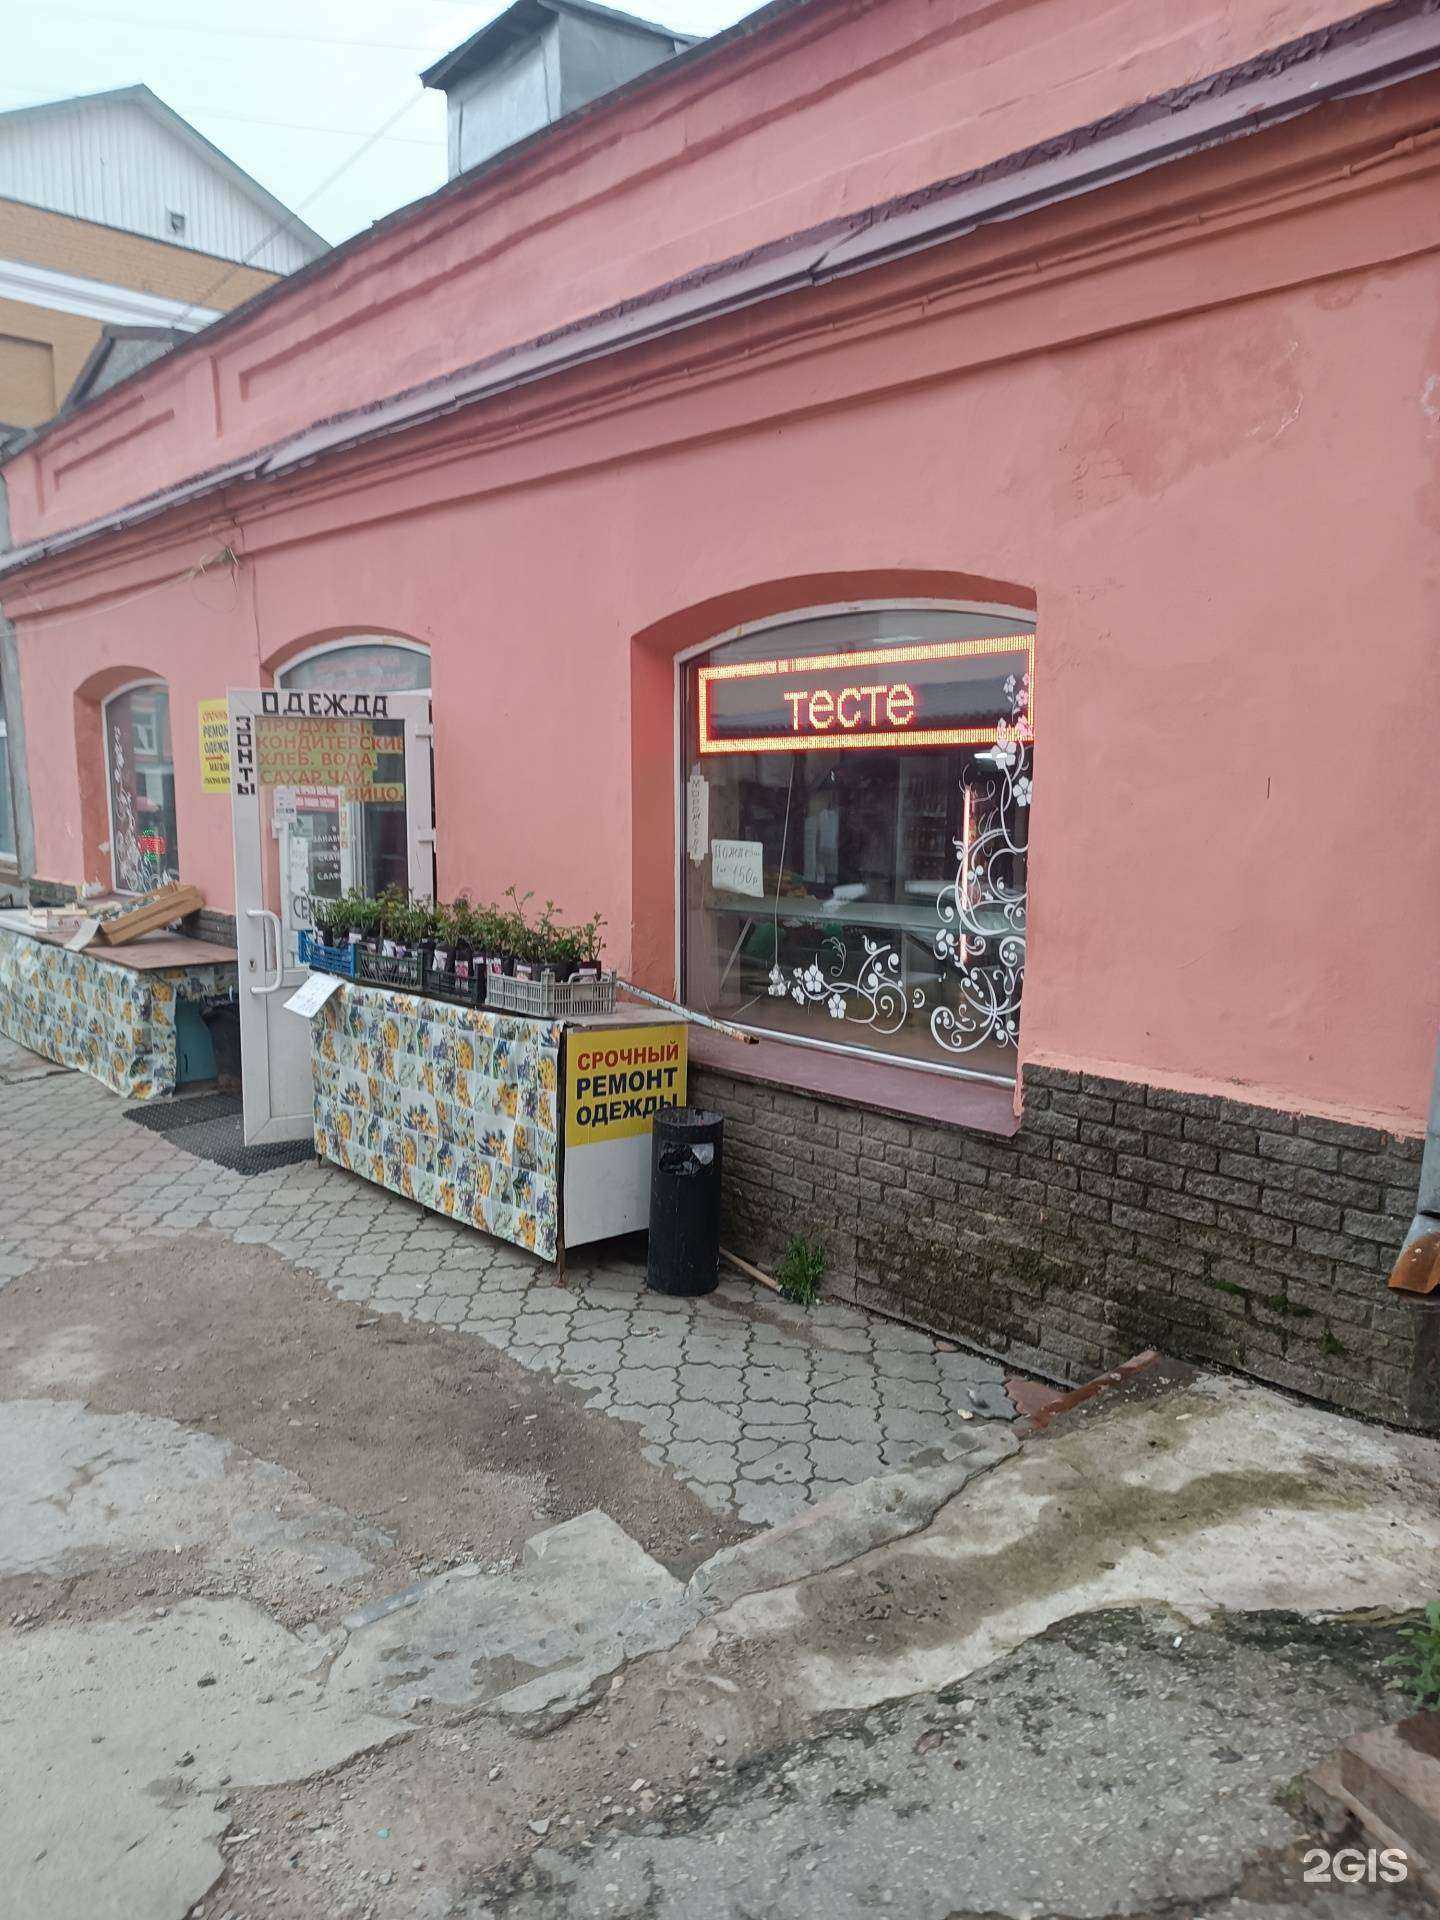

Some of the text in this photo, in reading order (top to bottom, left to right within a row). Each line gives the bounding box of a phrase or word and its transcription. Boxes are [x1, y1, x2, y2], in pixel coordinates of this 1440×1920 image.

[262, 692, 388, 718] ОДЕЖДА
[236, 716, 255, 795] ЗОНТЫ
[577, 1040, 679, 1071] СРОЧНЫЙ
[576, 1067, 678, 1099] РЕМОНТ
[576, 1094, 677, 1127] ОДЕЖДЫ
